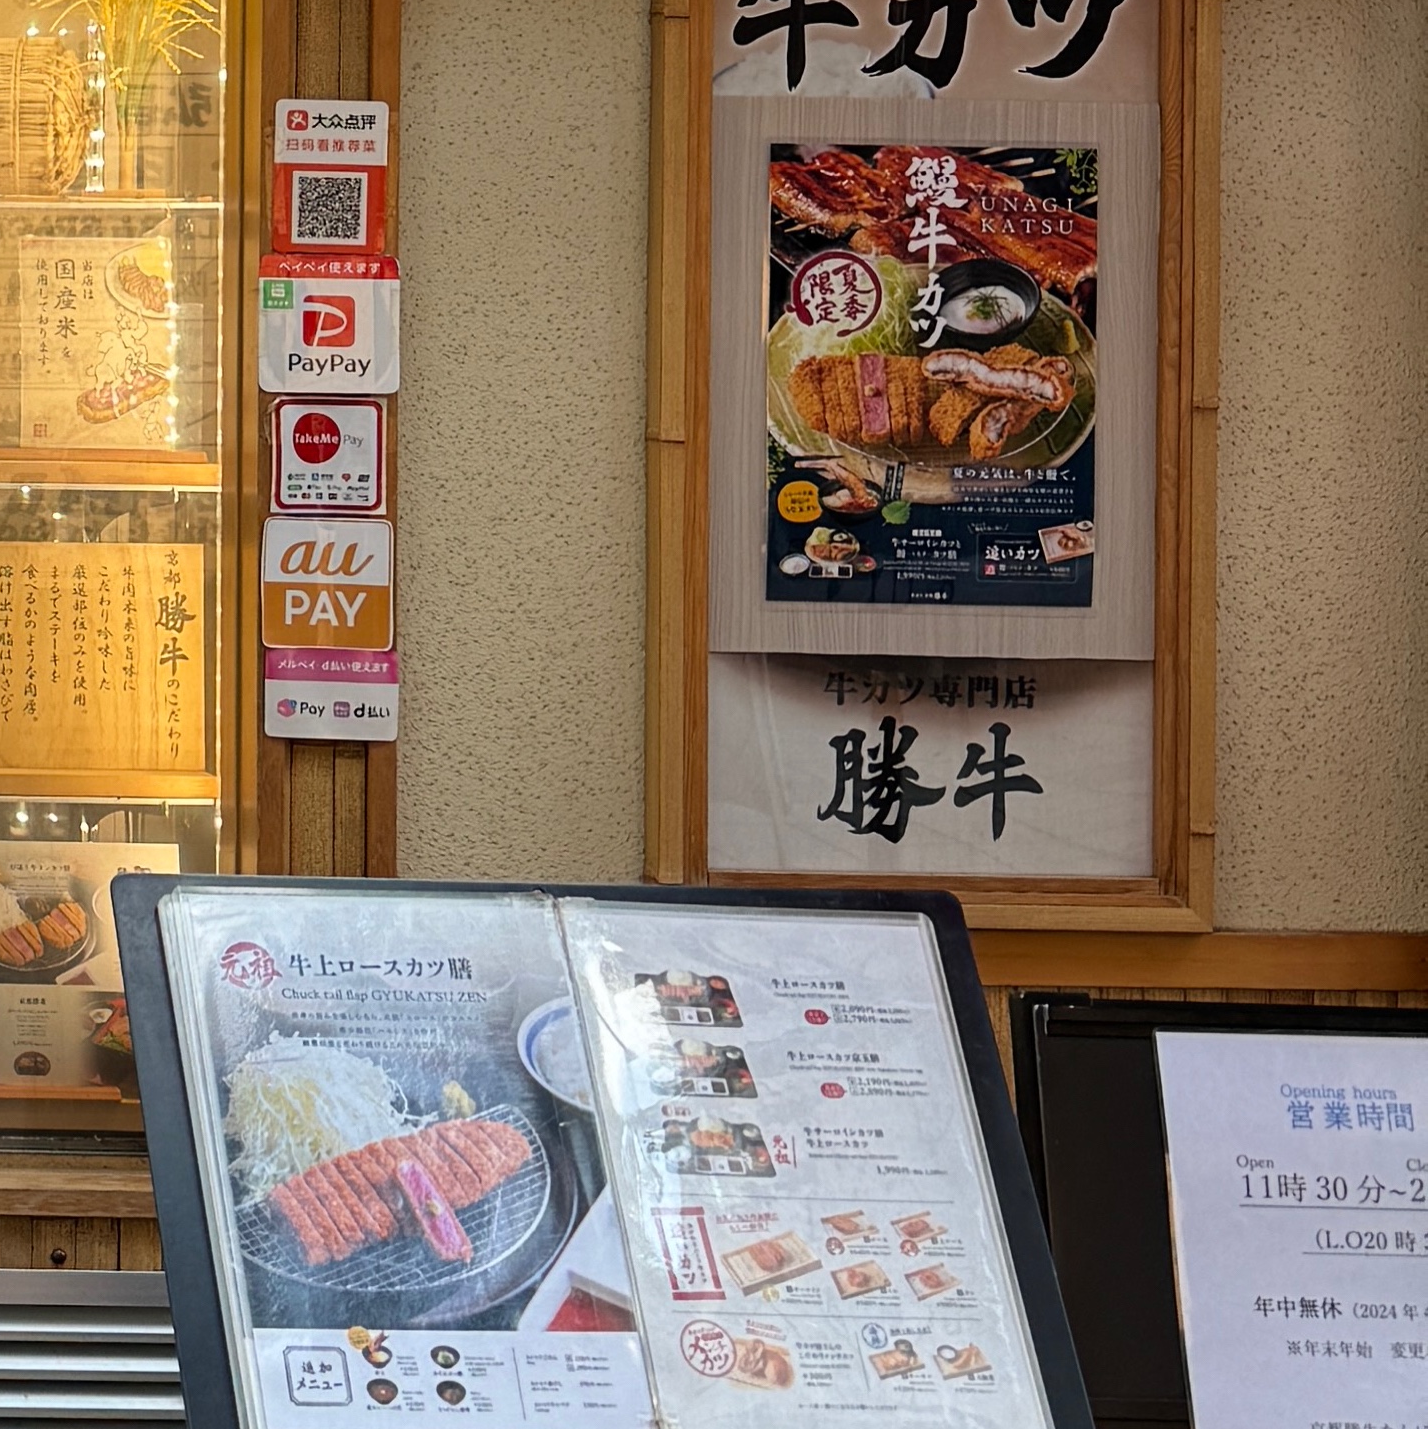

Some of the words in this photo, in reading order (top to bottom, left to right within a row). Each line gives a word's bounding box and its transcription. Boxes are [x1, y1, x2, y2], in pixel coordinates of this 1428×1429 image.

[311, 113, 377, 130] 大众点评
[980, 195, 1075, 214] UNAGI
[980, 218, 1075, 236] KATSU
[905, 155, 969, 349] 鰻牛カツ
[81, 259, 95, 300] 当店は
[278, 261, 381, 274] ペイペイ使えます
[53, 258, 79, 359] 国産米を
[288, 353, 372, 377] PayPay
[294, 432, 340, 445] TakeMe
[343, 434, 364, 449] Pay
[279, 540, 375, 577] au
[284, 589, 368, 628] PAY
[48, 564, 63, 685] まるでステーキを
[71, 563, 90, 715] 厳選部位のみを使用。
[95, 565, 114, 692] こだわり吟味した
[120, 565, 138, 693] 牛肉本来の旨味に
[823, 668, 1038, 712] 牛カツ専門店
[299, 702, 326, 718] Pay
[353, 702, 391, 719] d払い
[817, 717, 1043, 843] 勝牛
[289, 952, 474, 981] 牛上ロースカツ膳
[281, 987, 321, 1002] Chuck
[323, 988, 345, 1002] tail
[371, 989, 455, 1003] GYUKATSU
[457, 990, 488, 1003] ZEN
[1280, 1084, 1346, 1103] Opening
[1353, 1085, 1398, 1101] hours
[1287, 1100, 1415, 1132] 営業時間
[1236, 1154, 1276, 1171] Open
[1253, 1295, 1343, 1320] 年中無休
[296, 1376, 344, 1391] メニュー
